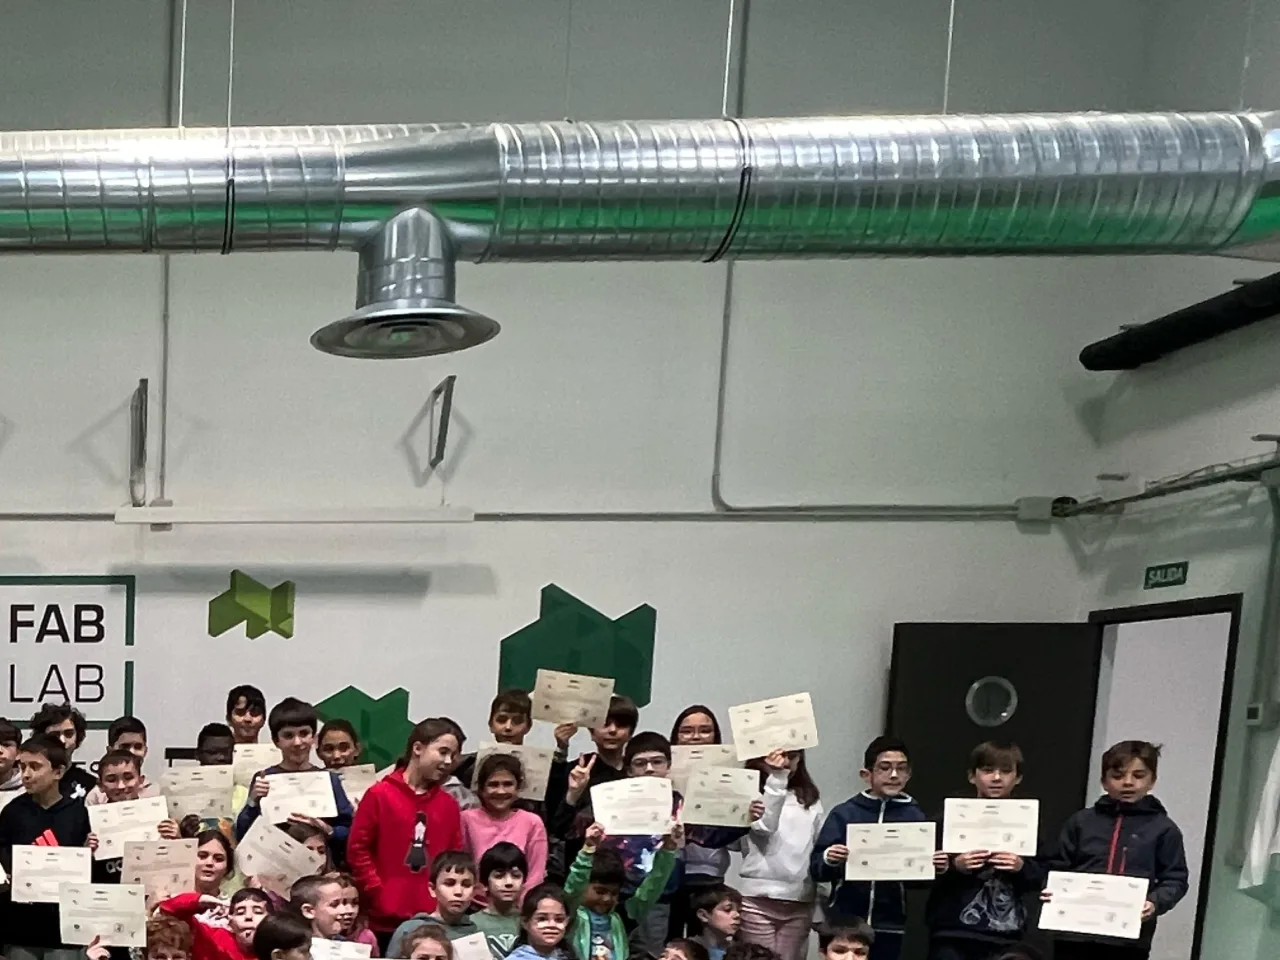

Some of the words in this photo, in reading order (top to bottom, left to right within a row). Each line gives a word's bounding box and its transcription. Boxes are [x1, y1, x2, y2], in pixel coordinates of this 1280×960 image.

[1148, 567, 1184, 583] SALIDA
[9, 604, 105, 643] FAB
[9, 664, 105, 703] LAB
